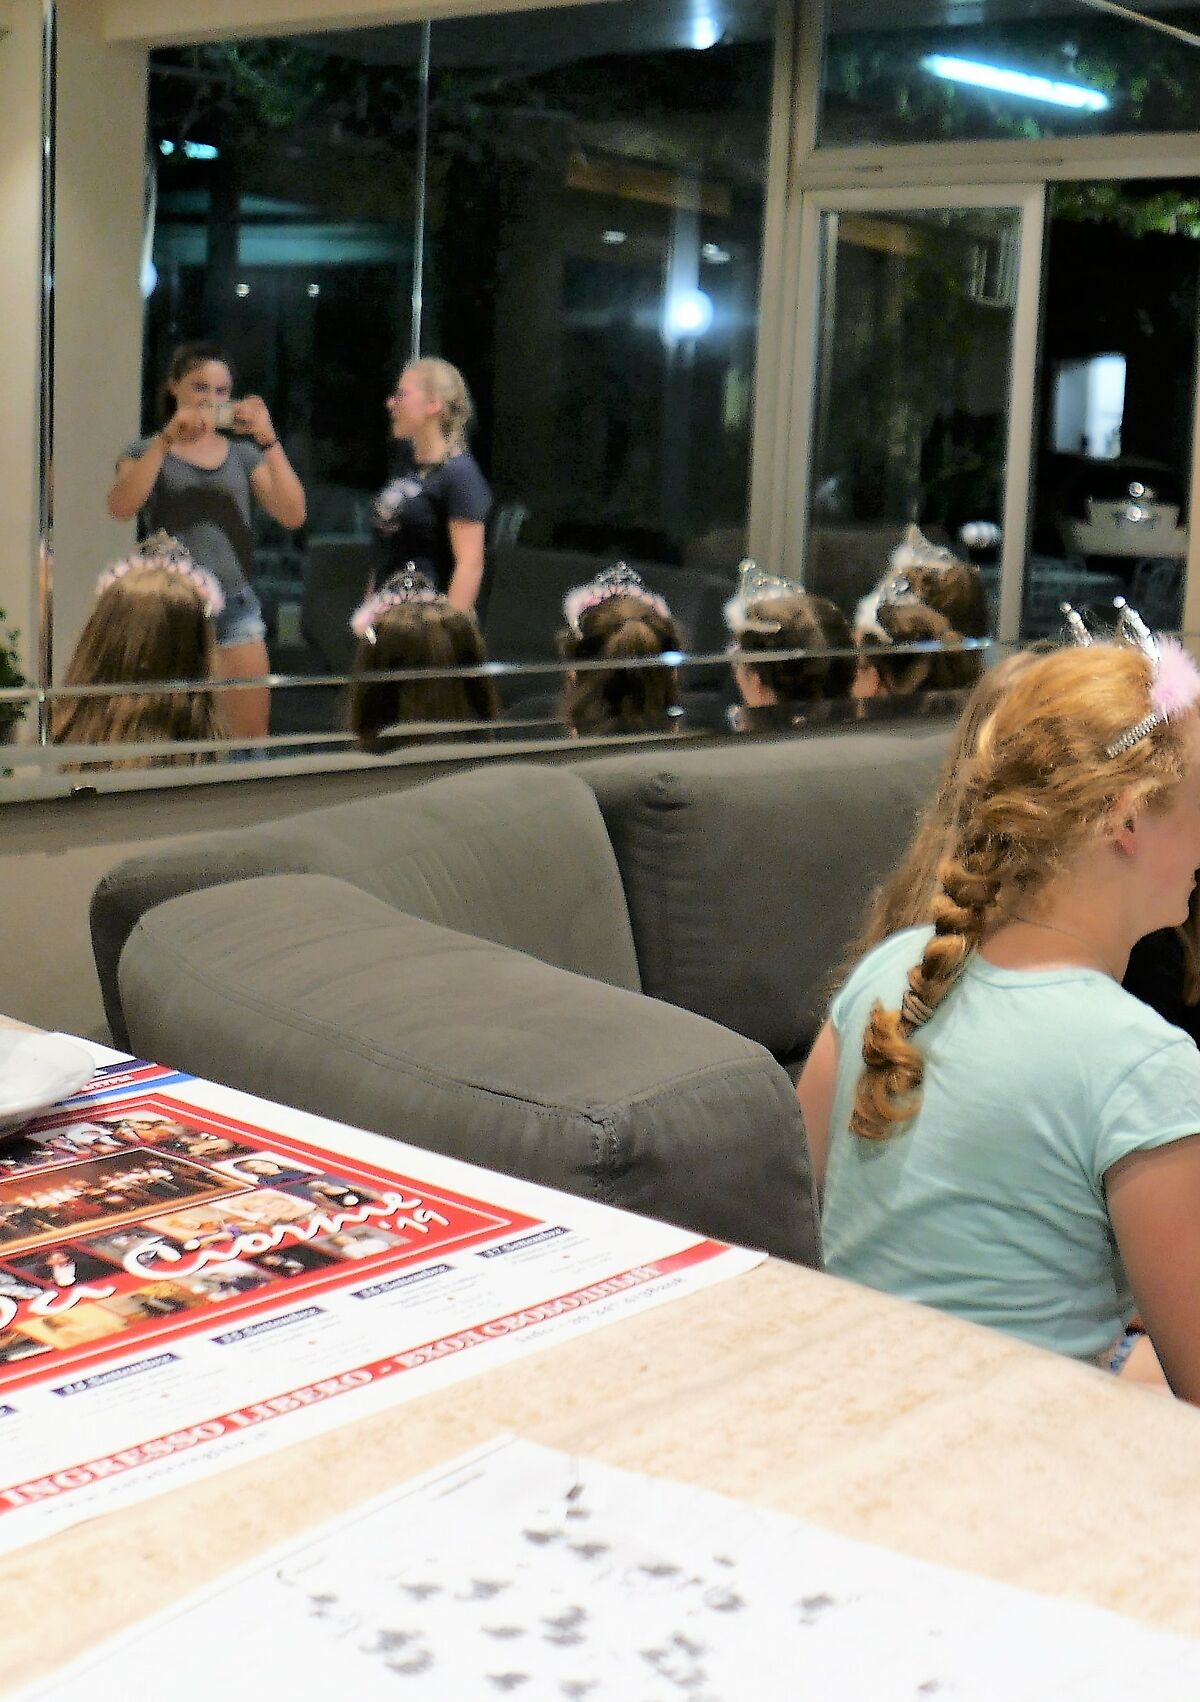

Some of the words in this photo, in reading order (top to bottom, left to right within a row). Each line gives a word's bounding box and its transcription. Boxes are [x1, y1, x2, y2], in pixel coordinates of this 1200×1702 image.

[123, 1191, 423, 1281] Ciornie
[5, 1421, 227, 1507] INGRESSO
[226, 1370, 374, 1428] LIBERO
